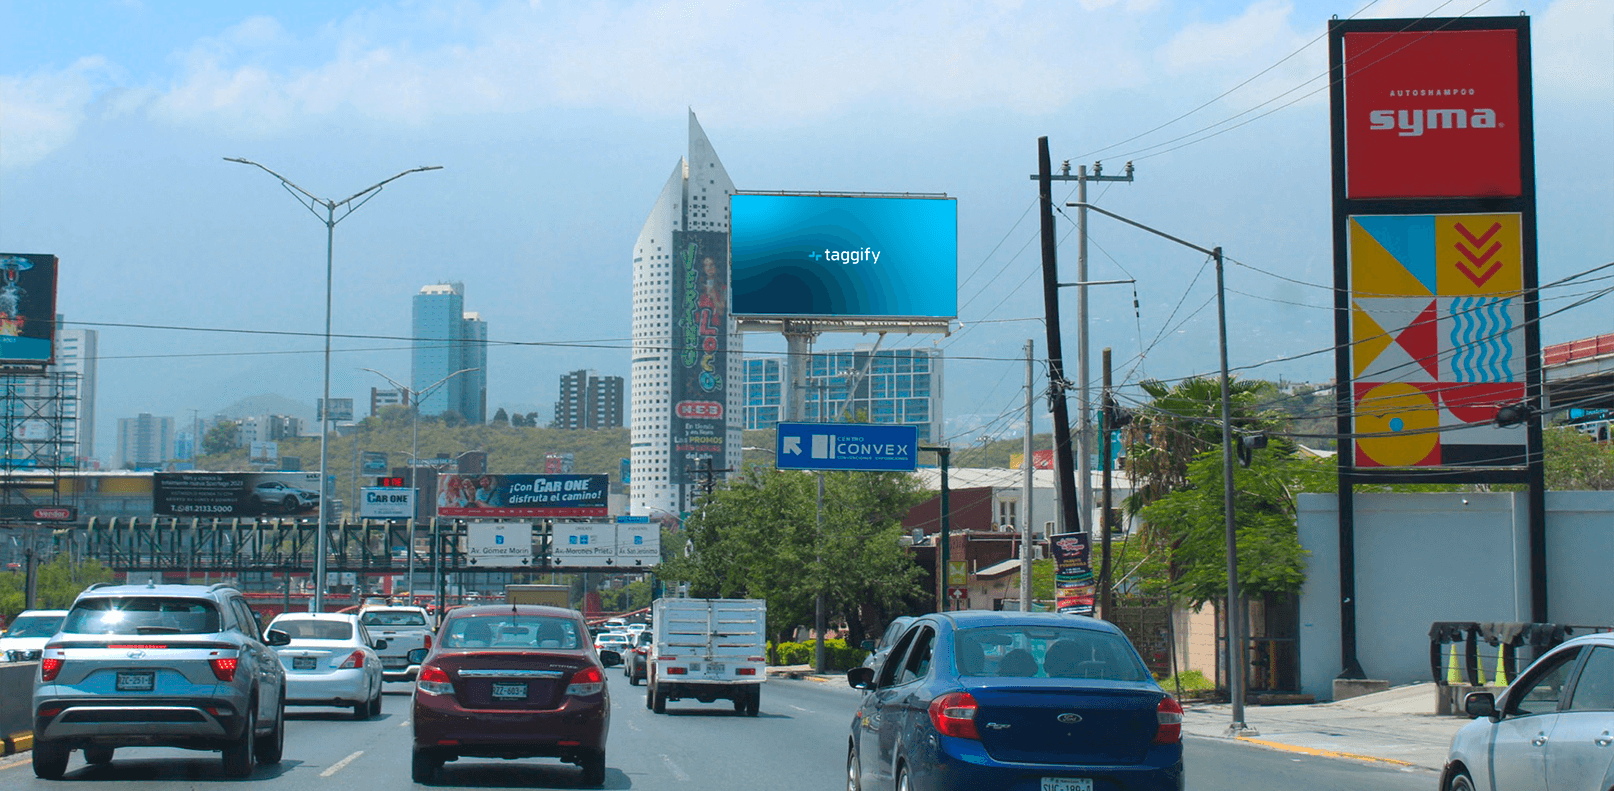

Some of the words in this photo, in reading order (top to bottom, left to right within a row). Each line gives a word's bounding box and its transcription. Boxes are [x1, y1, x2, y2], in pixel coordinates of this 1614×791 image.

[1389, 88, 1476, 97] AUTOSHAMPOO
[1369, 108, 1497, 137] syma
[824, 246, 881, 265] taggify
[689, 436, 723, 444] PROMOS
[836, 443, 908, 456] CONVEX
[508, 482, 533, 494] ¡Con
[533, 477, 562, 493] CAR
[563, 479, 590, 492] ONE
[366, 491, 389, 503] CAR
[389, 494, 408, 503] ONE
[508, 493, 548, 504] disfruta
[550, 493, 561, 502] el
[562, 490, 602, 501] camino!
